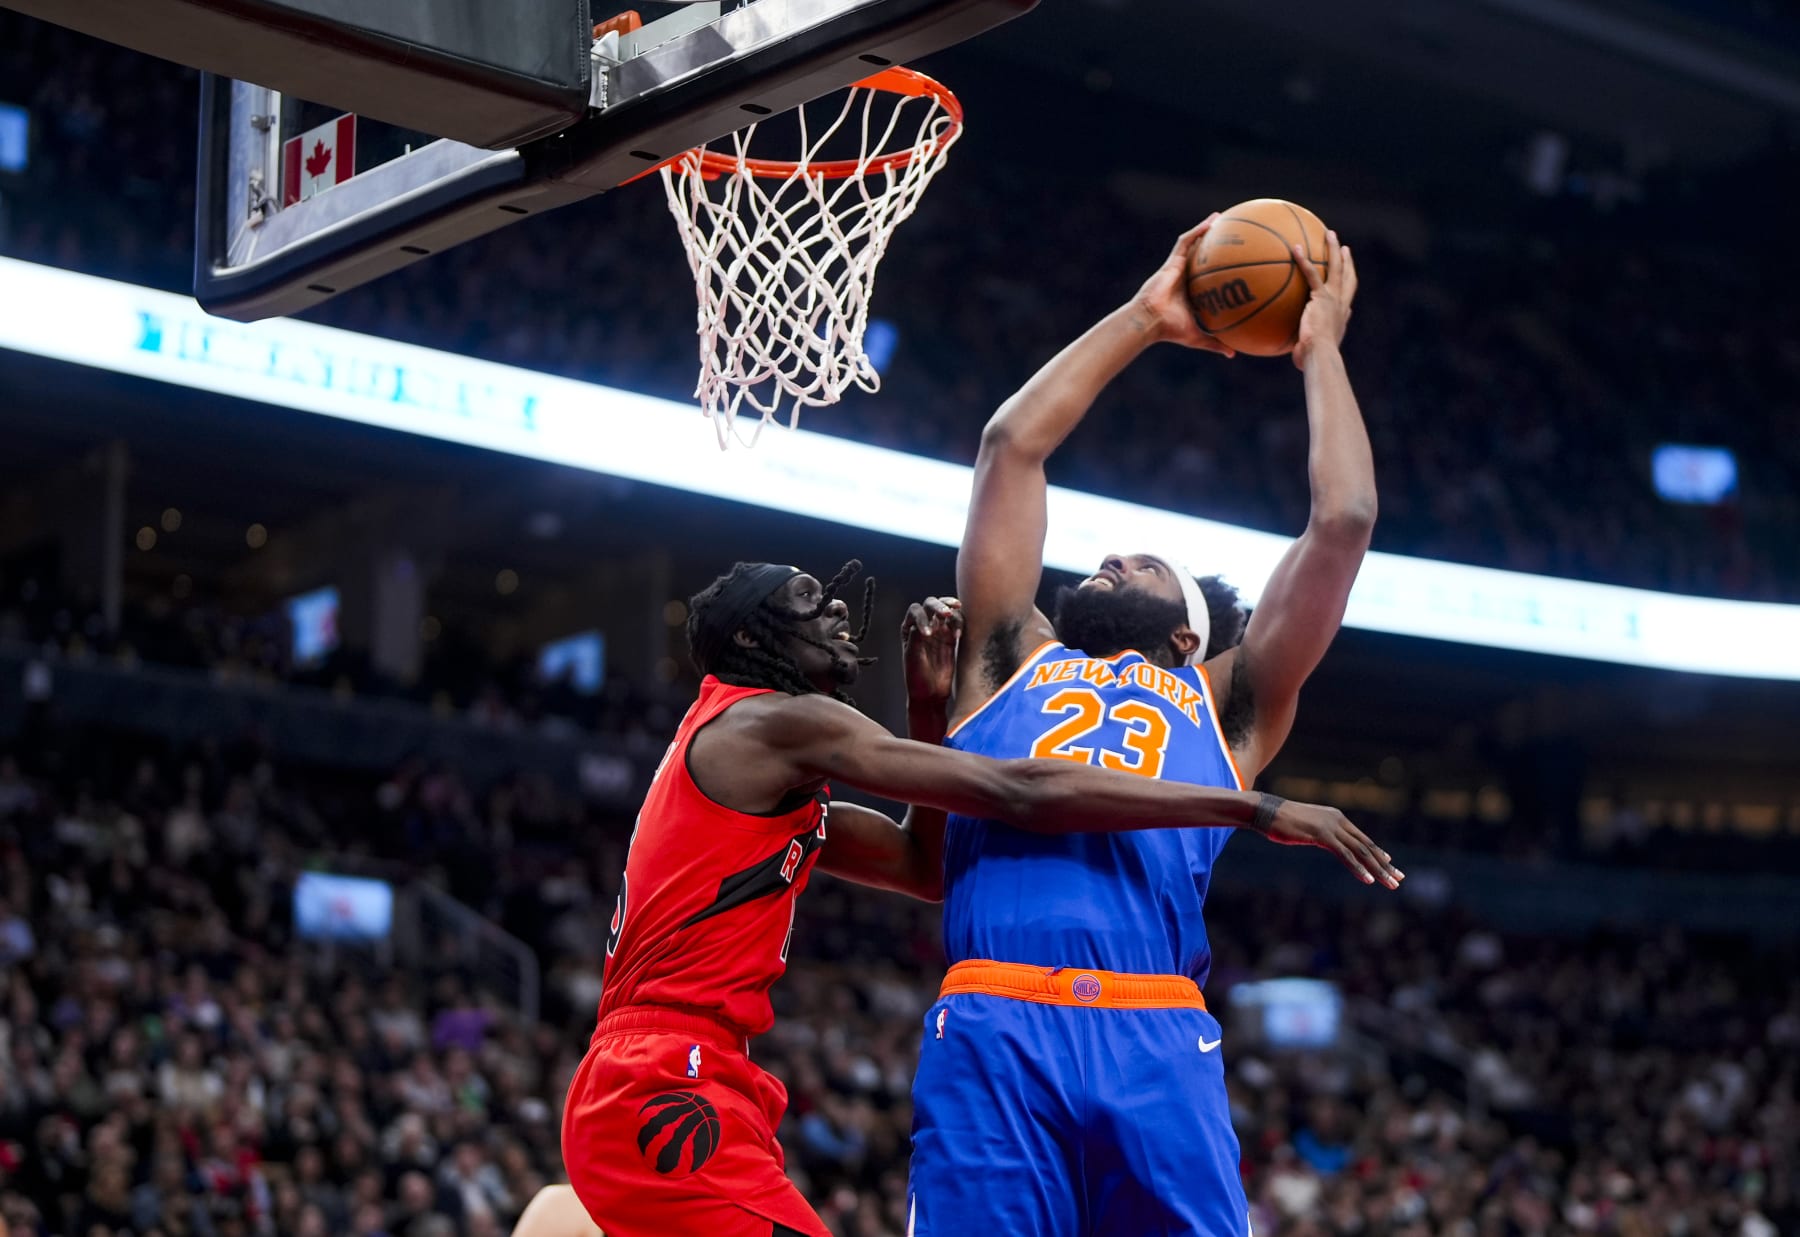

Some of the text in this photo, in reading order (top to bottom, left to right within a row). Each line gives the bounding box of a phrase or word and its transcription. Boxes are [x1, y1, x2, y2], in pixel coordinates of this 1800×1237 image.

[1024, 658, 1203, 729] NEW YORK
[1029, 687, 1171, 779] 23
